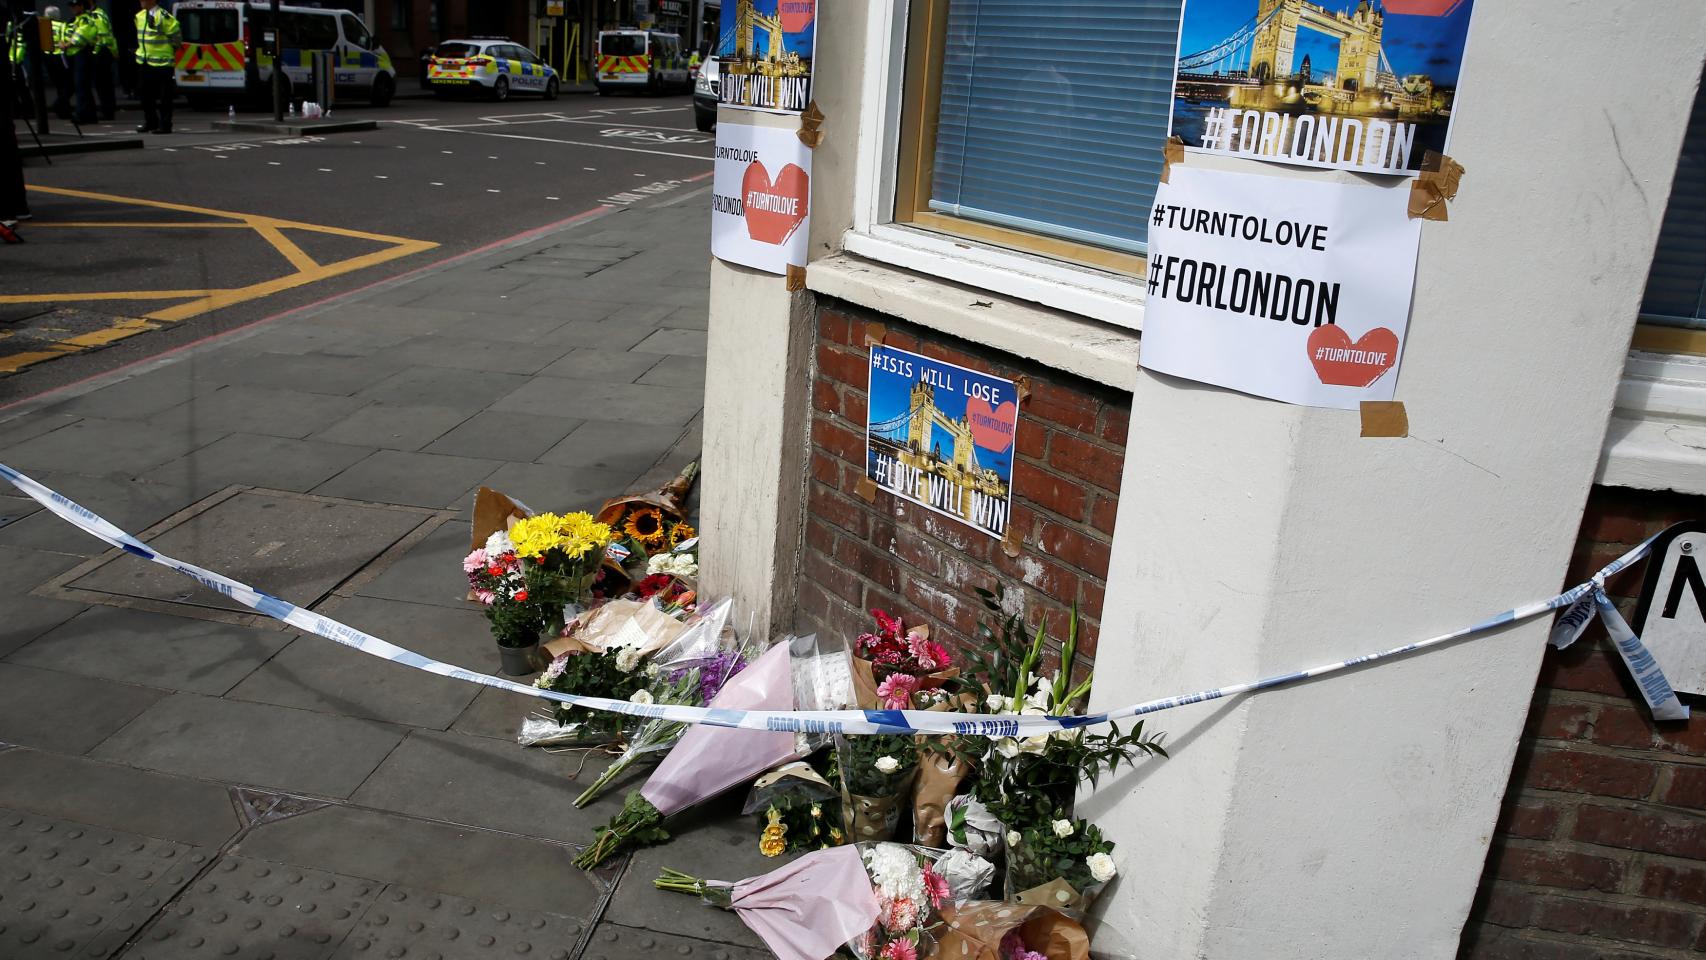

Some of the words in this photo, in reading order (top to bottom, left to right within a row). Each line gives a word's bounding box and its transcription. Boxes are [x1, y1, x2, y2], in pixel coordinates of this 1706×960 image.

[512, 76, 544, 86] POLICE
[751, 75, 775, 106] WILL
[780, 77, 808, 110] WIN
[1201, 107, 1416, 170] #FORLONDON
[747, 191, 799, 216] #TURNTOLOVE
[1153, 204, 1328, 252] #TURNTOLOVE
[1147, 253, 1341, 328] #FORLONDON
[1315, 347, 1388, 366] #TURNTOLOVE
[873, 353, 912, 378] #ISIS
[921, 366, 954, 392] WILL
[964, 379, 999, 405] LOSE
[972, 413, 1013, 436] #TURNTOLOVE
[875, 453, 924, 500] #LOVE
[928, 473, 964, 517] WILL
[971, 491, 1006, 533] WIN
[952, 721, 979, 736] LINE
[981, 720, 1019, 737] POLICE
